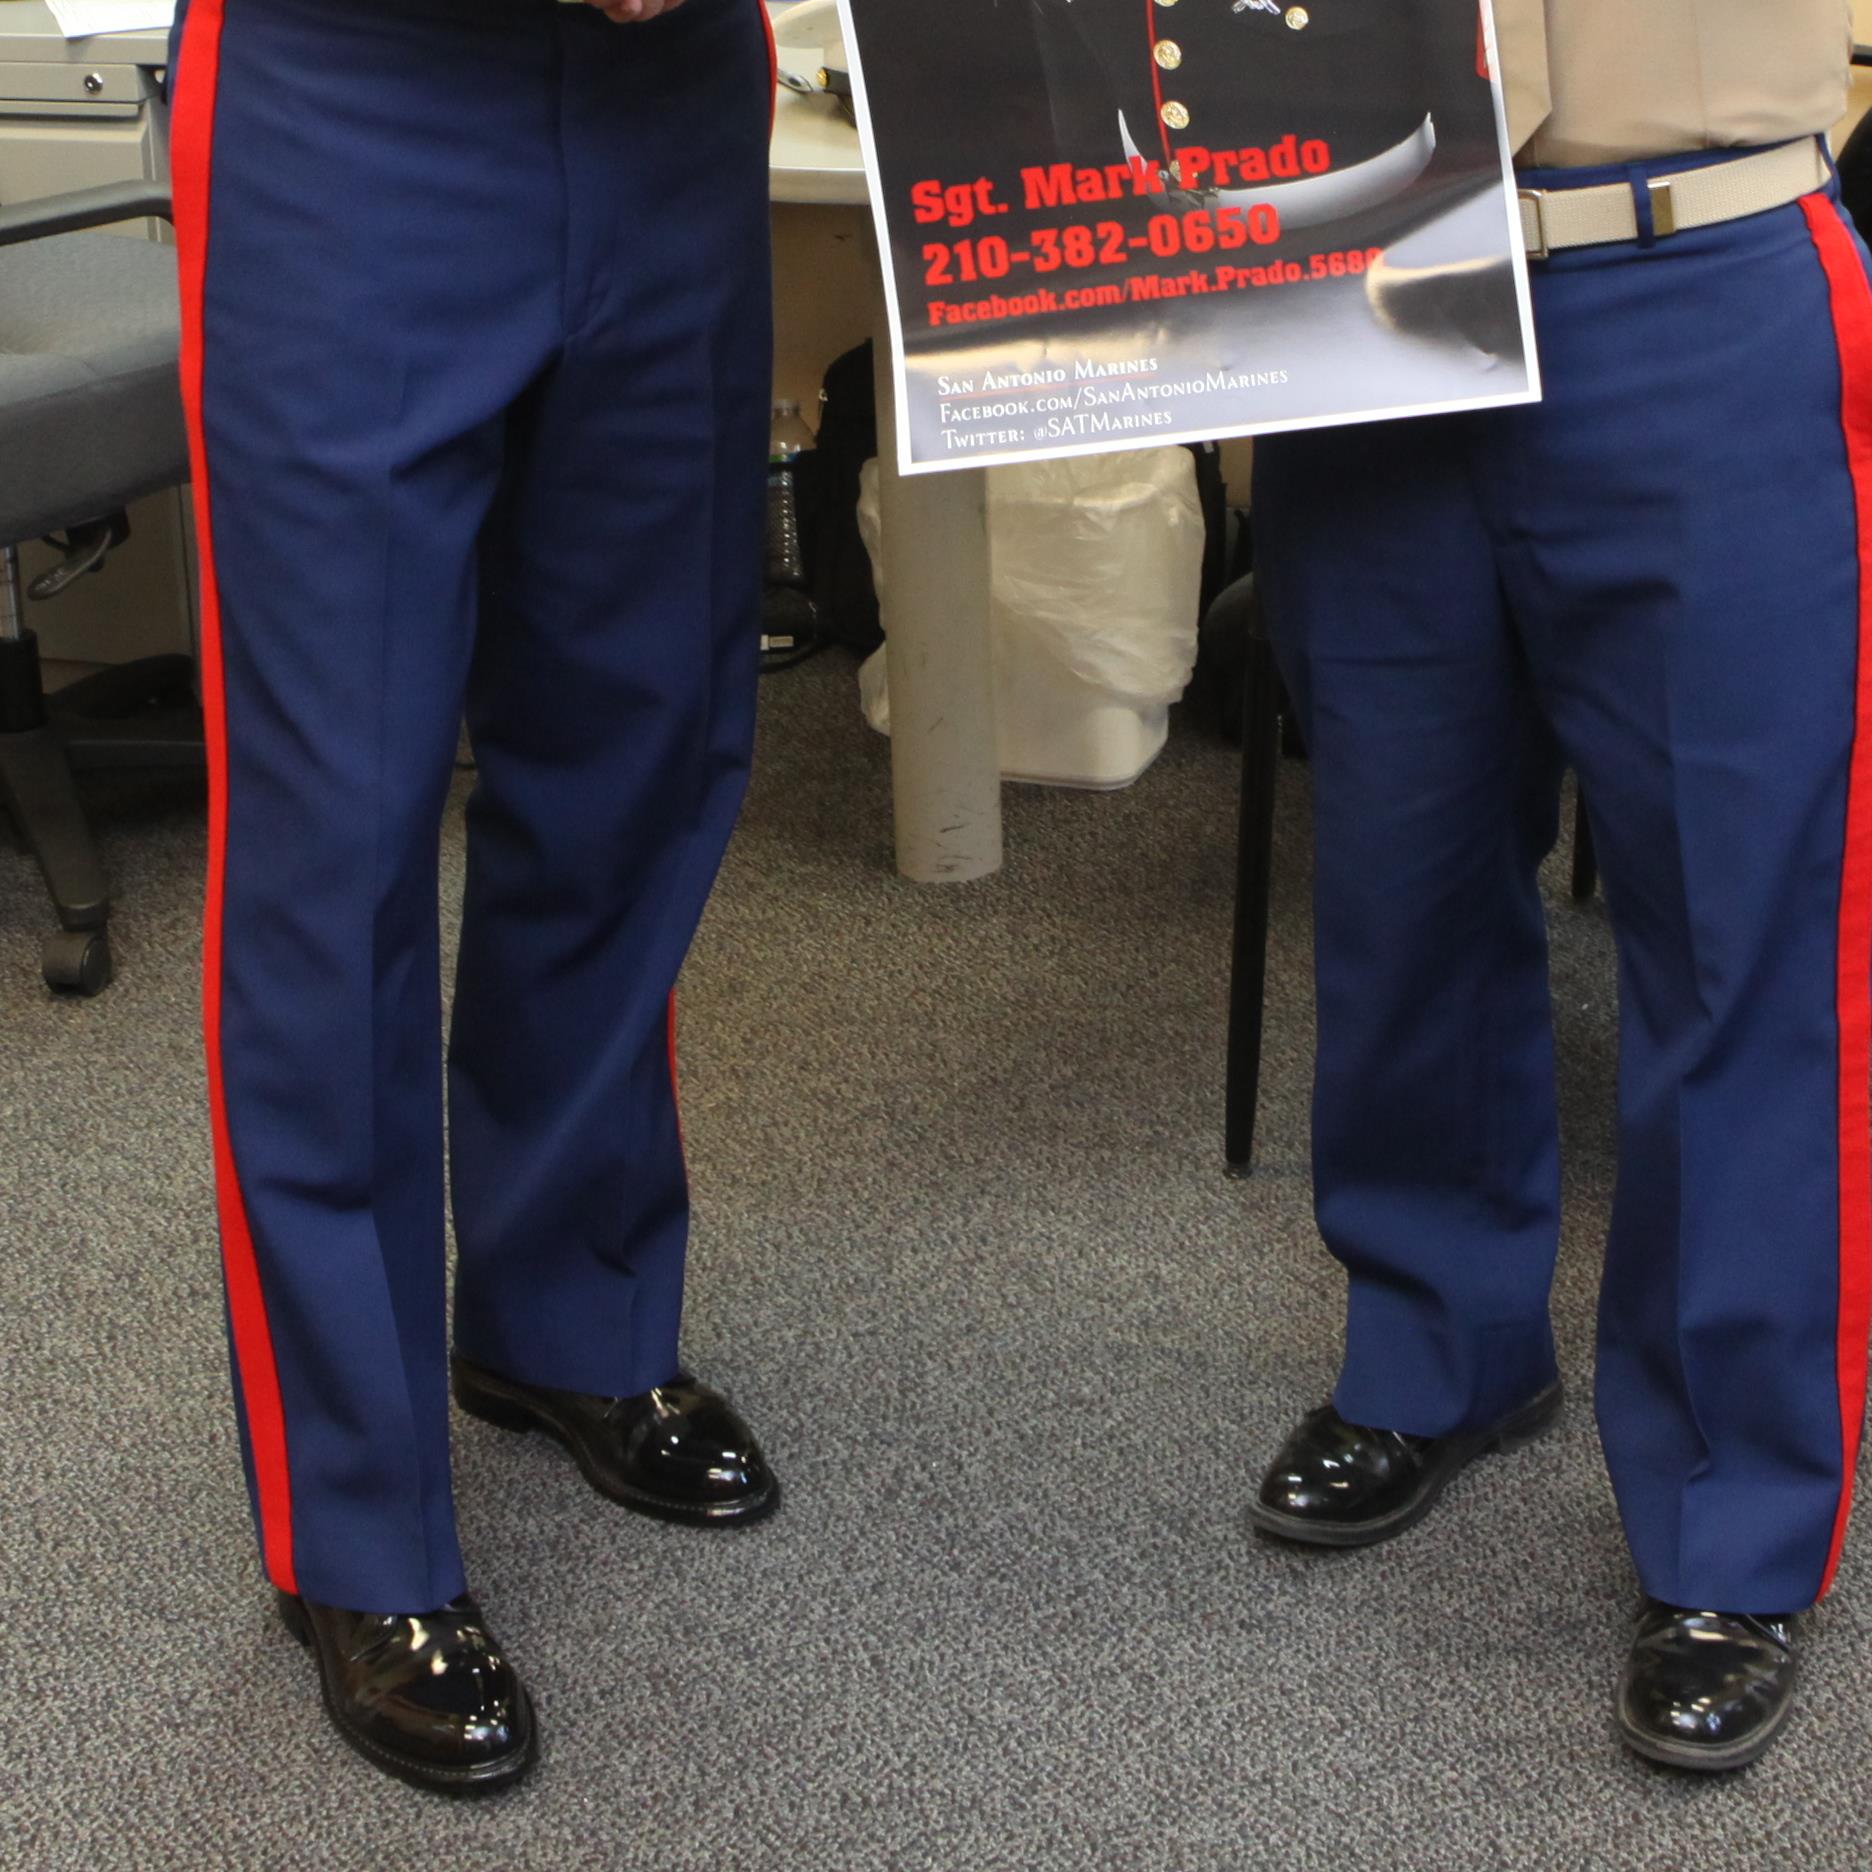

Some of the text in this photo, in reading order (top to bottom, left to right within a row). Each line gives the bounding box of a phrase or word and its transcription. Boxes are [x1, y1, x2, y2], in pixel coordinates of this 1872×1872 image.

[911, 134, 1331, 228] Sgt. Mark Prado
[921, 202, 1282, 288] 210-382-0650
